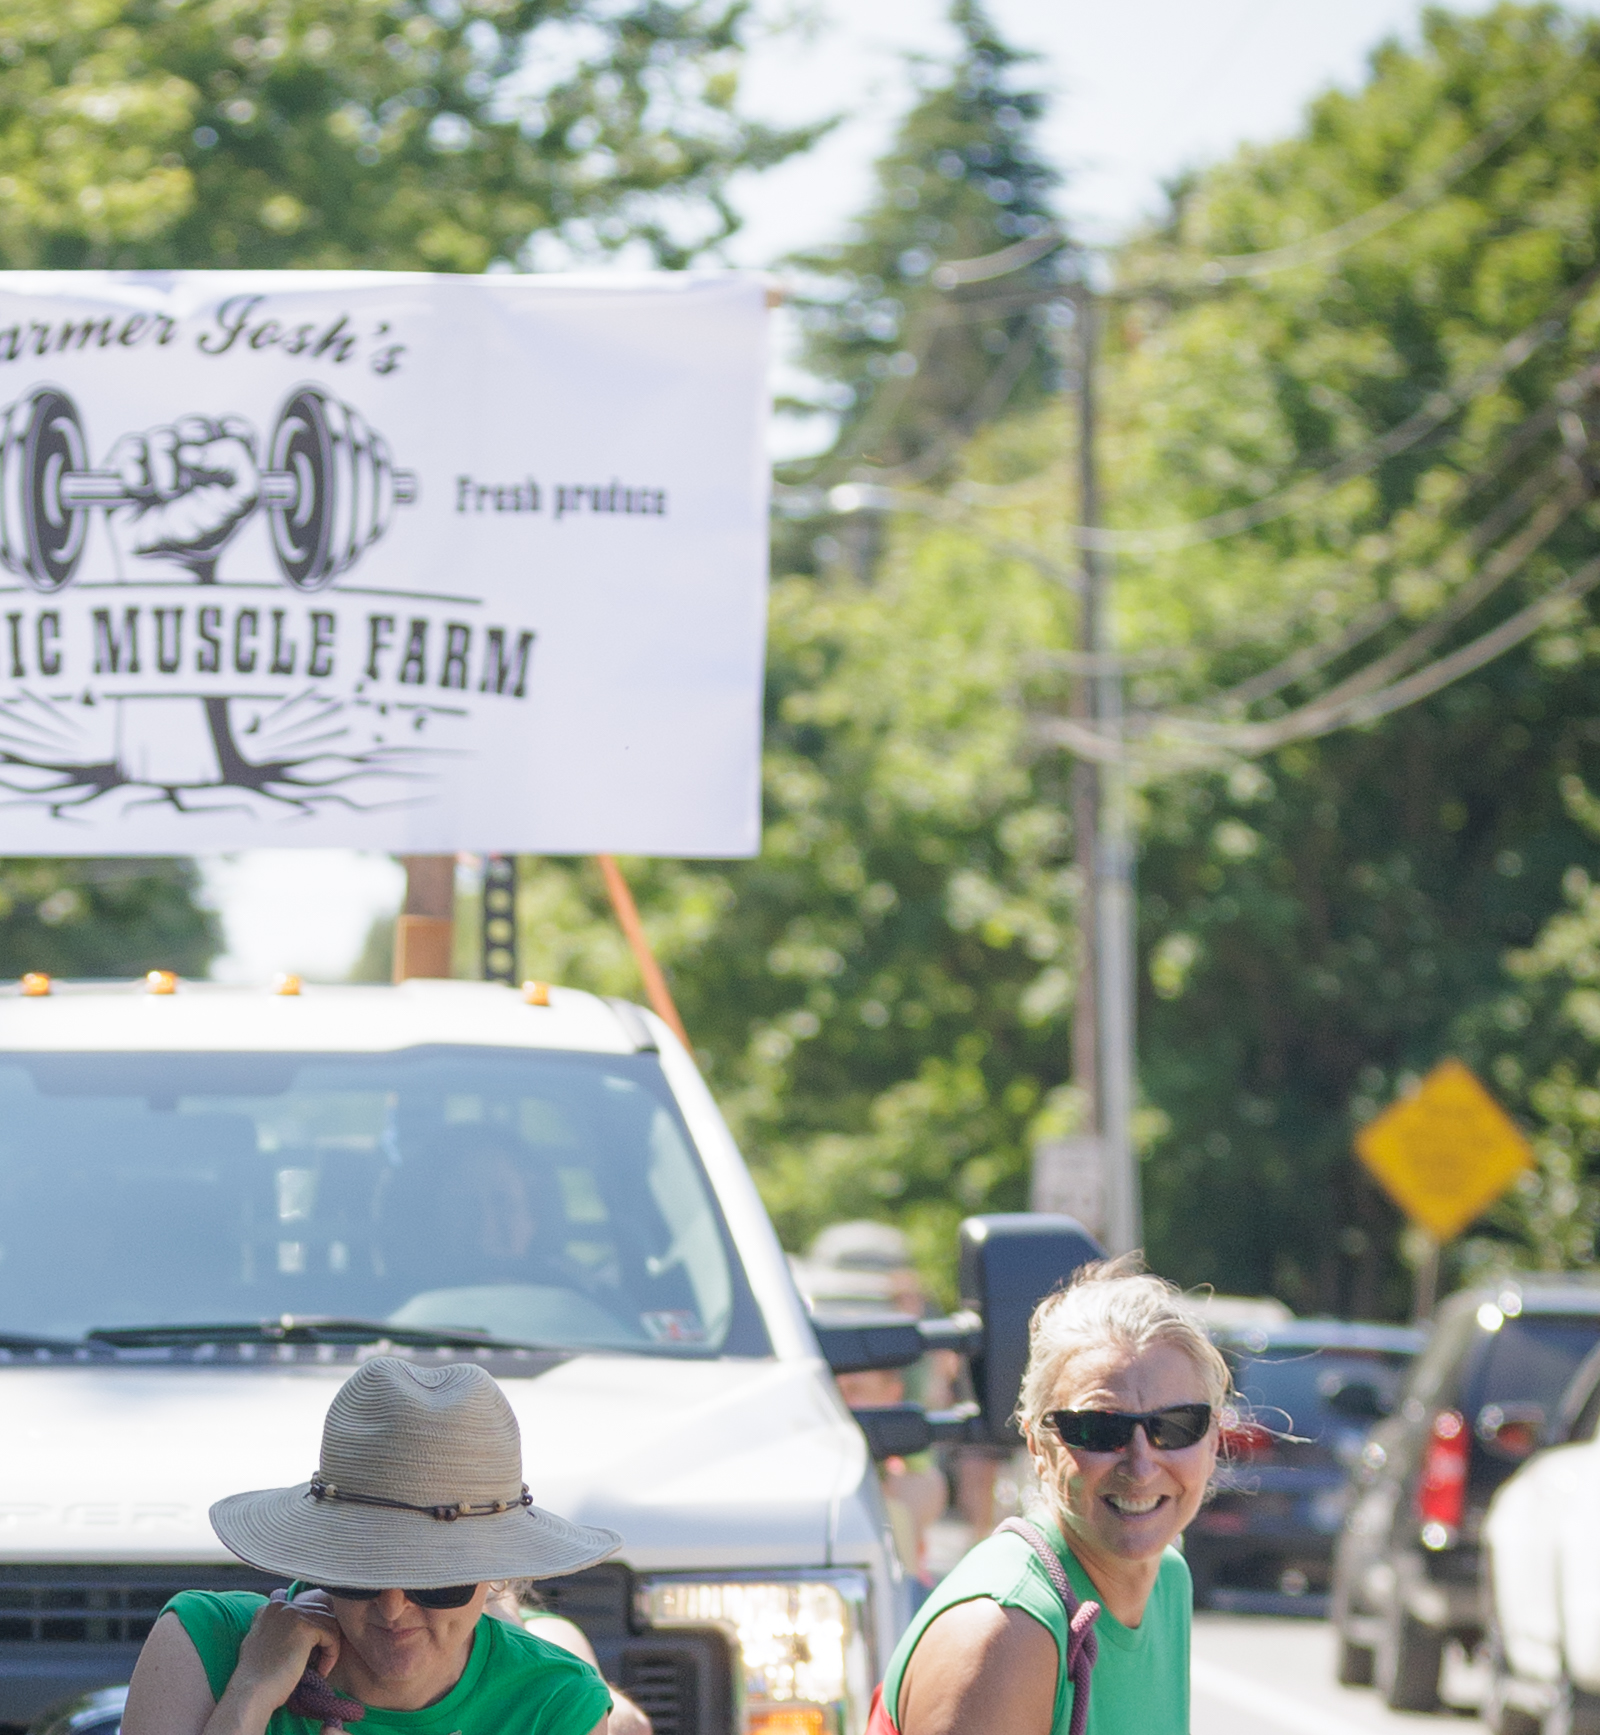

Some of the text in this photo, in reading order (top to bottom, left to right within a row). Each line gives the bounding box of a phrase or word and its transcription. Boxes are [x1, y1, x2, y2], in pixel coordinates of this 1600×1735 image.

[198, 293, 407, 376] Josh's
[456, 474, 666, 521] Fresh produce
[92, 607, 336, 678] MUSCLE
[366, 614, 536, 699] FARM
